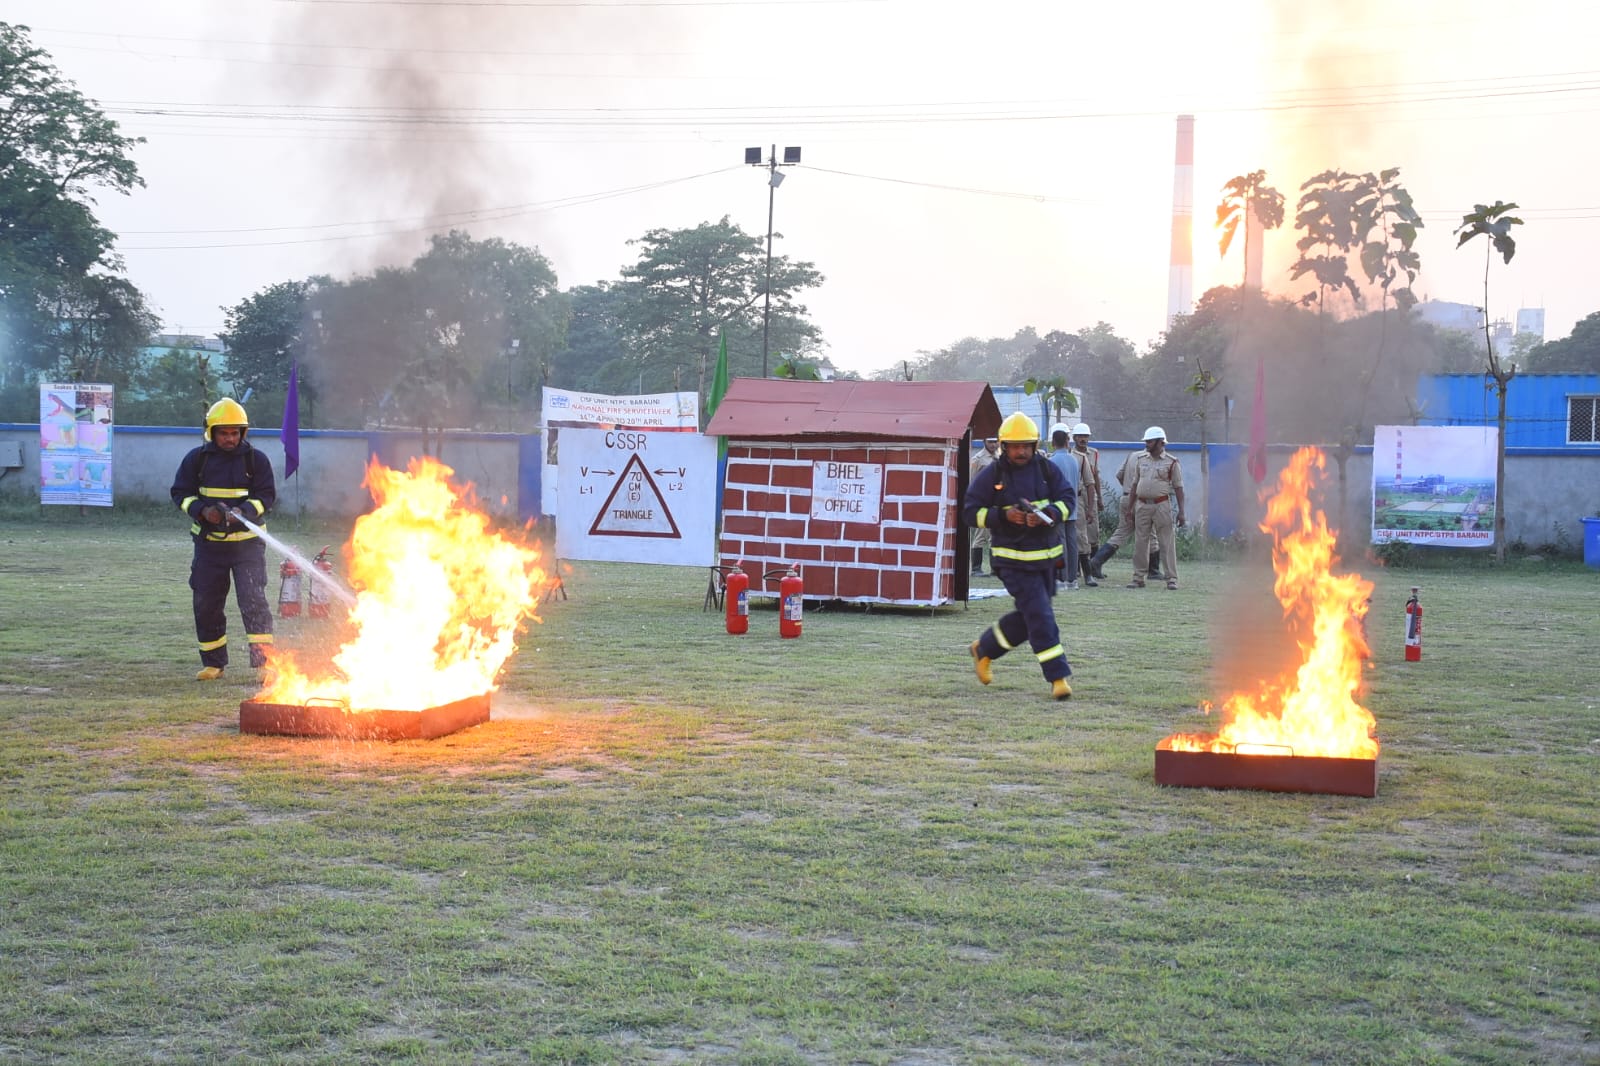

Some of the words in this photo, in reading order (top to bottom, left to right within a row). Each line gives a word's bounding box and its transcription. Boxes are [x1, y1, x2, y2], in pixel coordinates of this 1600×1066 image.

[605, 432, 647, 451] CSSR
[580, 466, 588, 477] V
[630, 471, 642, 482] 70
[678, 467, 686, 478] V
[827, 463, 864, 480] BHEL
[840, 483, 865, 494] SITE
[824, 499, 863, 513] OFFICE
[612, 510, 653, 520] TRIANGLE
